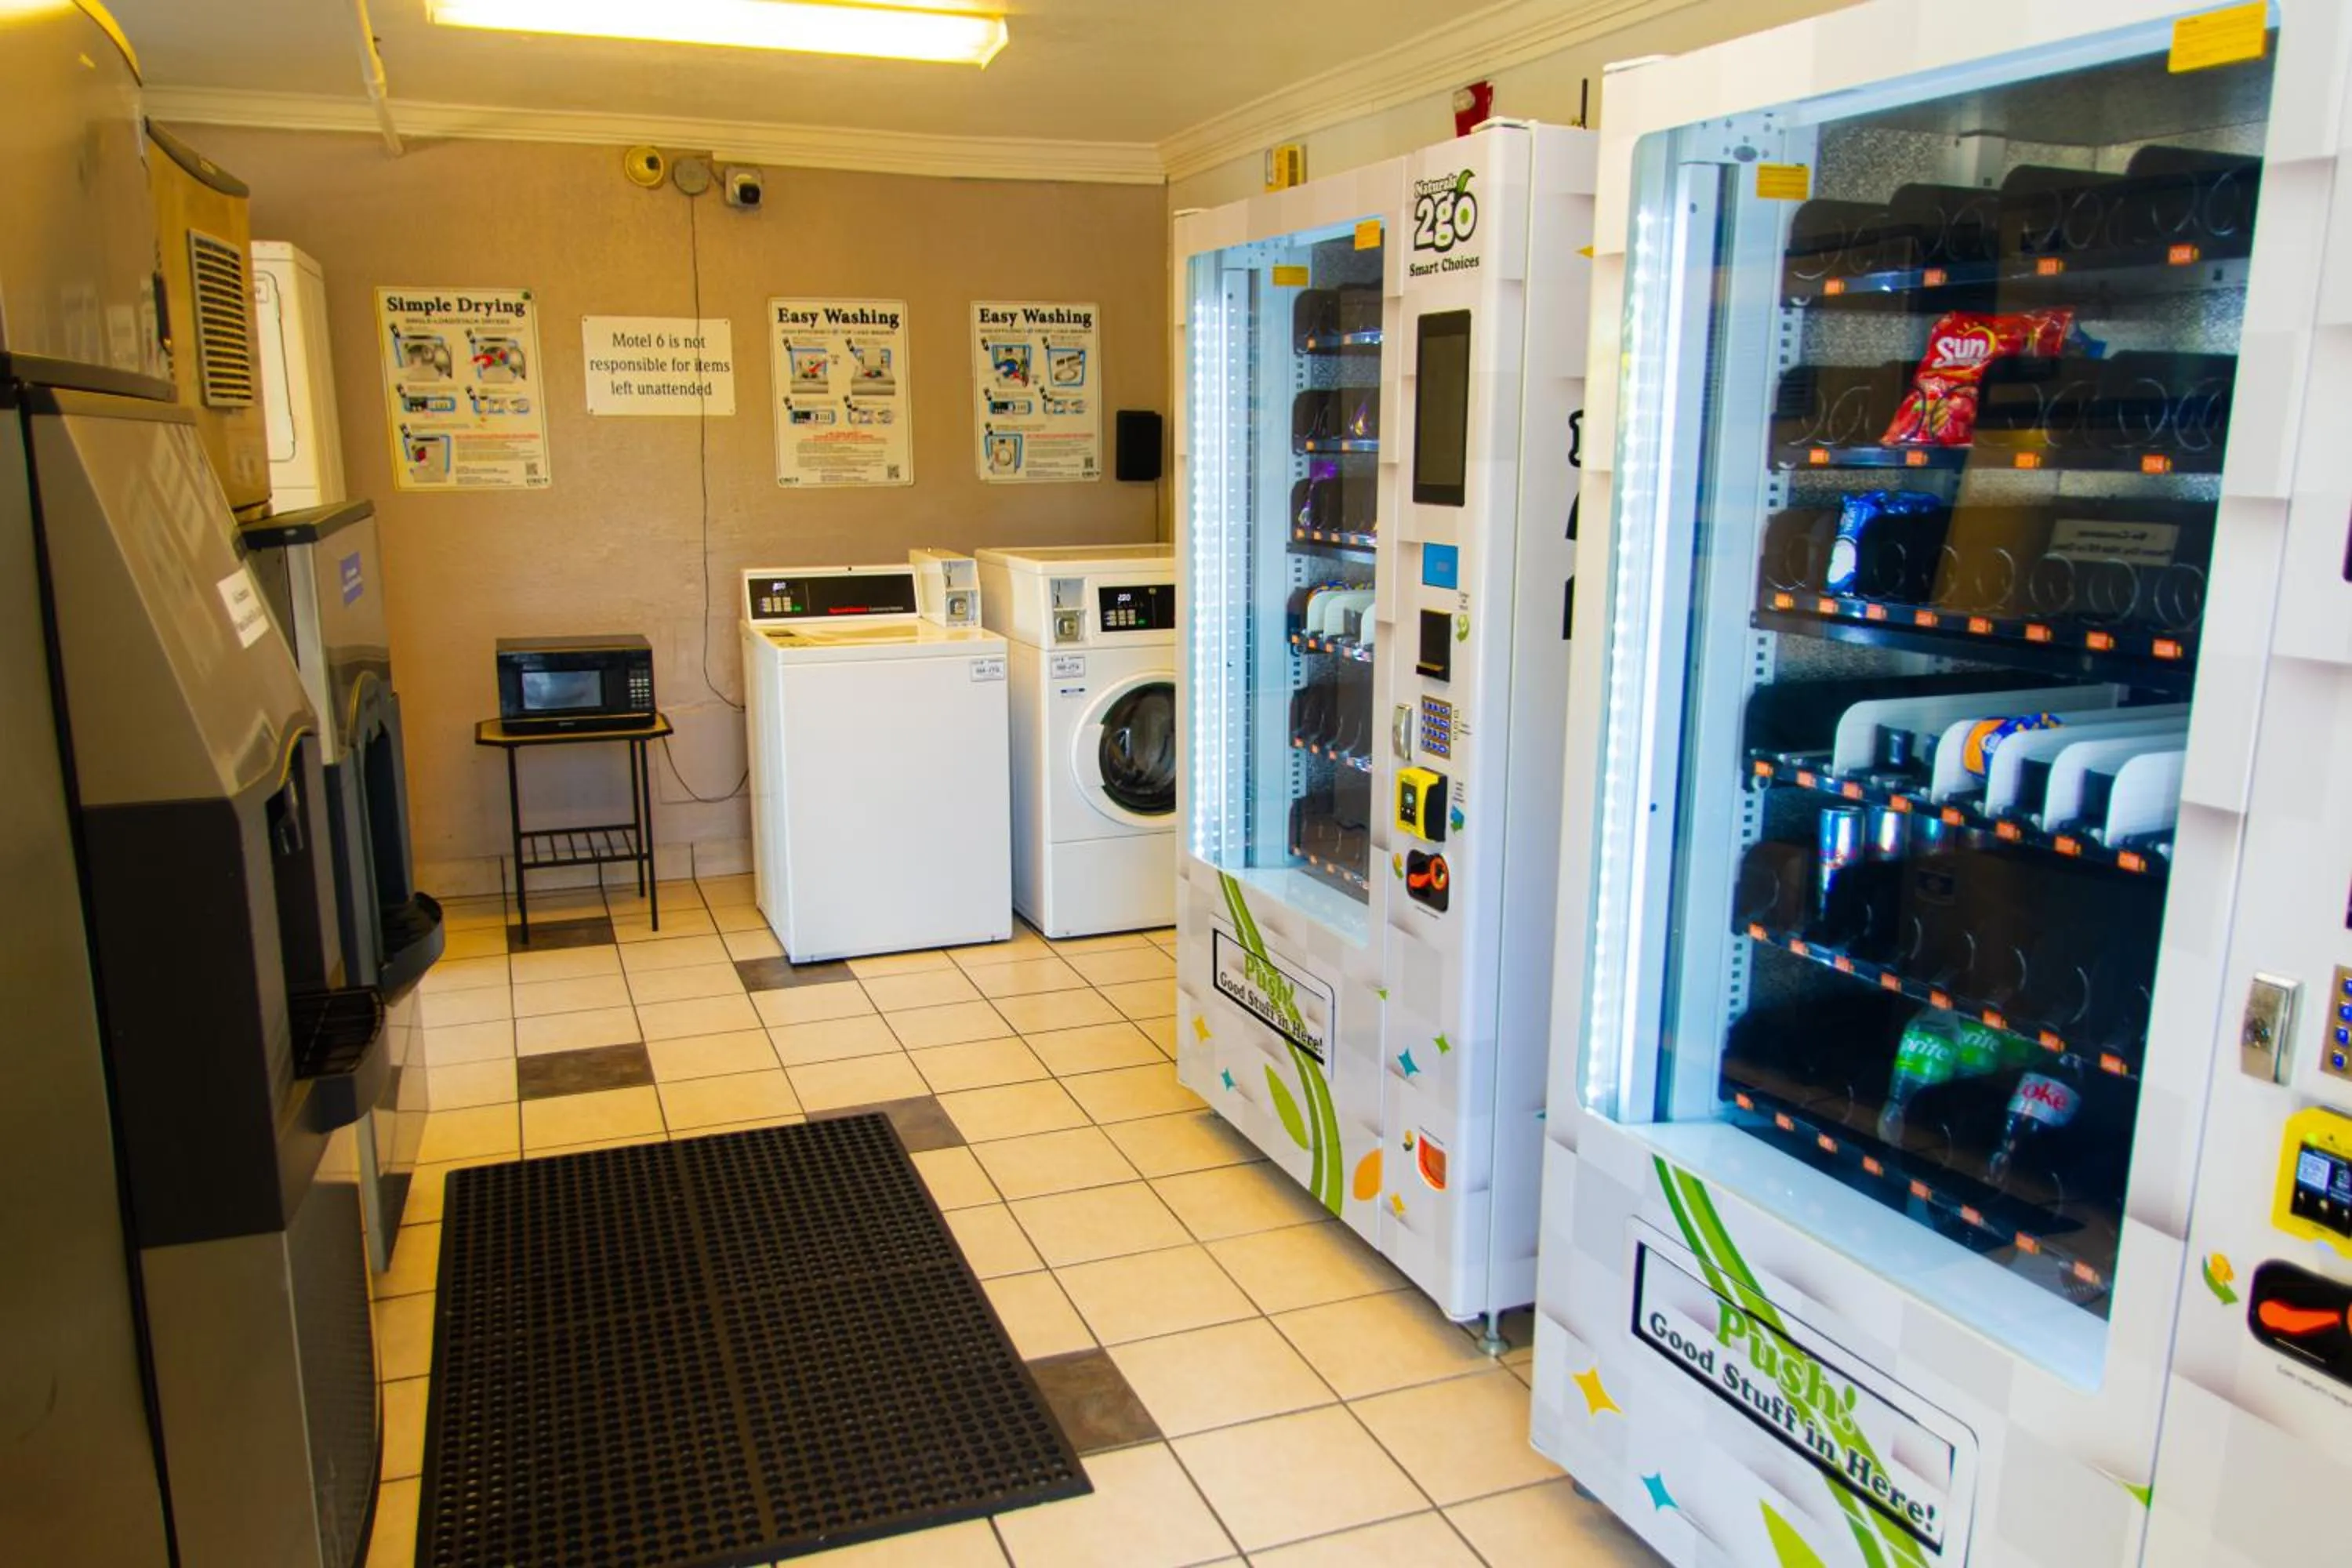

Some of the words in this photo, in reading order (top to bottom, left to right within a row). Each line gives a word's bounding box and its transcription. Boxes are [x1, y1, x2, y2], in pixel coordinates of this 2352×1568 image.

[1410, 261, 1439, 278] Smart
[1442, 256, 1480, 273] Choices
[387, 296, 452, 316] Simple
[456, 297, 526, 317] Drying
[777, 307, 818, 328] Easy
[823, 308, 900, 328] Washing
[978, 308, 1018, 328] Easy
[1022, 308, 1092, 328] Washing
[612, 332, 652, 348] Motel
[656, 334, 665, 349] 6
[669, 333, 681, 349] is
[684, 335, 706, 349] not
[1932, 336, 1986, 369] Sun
[590, 357, 668, 373] responsible
[672, 358, 691, 372] for
[695, 358, 731, 372] items
[611, 379, 633, 395] left
[637, 380, 713, 396] unattended
[1219, 971, 1246, 1000] Good
[1247, 989, 1276, 1022] Stuff
[1278, 1010, 1290, 1031] in
[1292, 1019, 1323, 1054] Here!
[2020, 1080, 2070, 1112] oke
[1715, 1298, 1858, 1433] Push!
[1650, 1312, 1715, 1376] Good
[1722, 1362, 1798, 1435] Stuff
[1805, 1421, 1837, 1461] in
[1845, 1445, 1937, 1534] Here!
